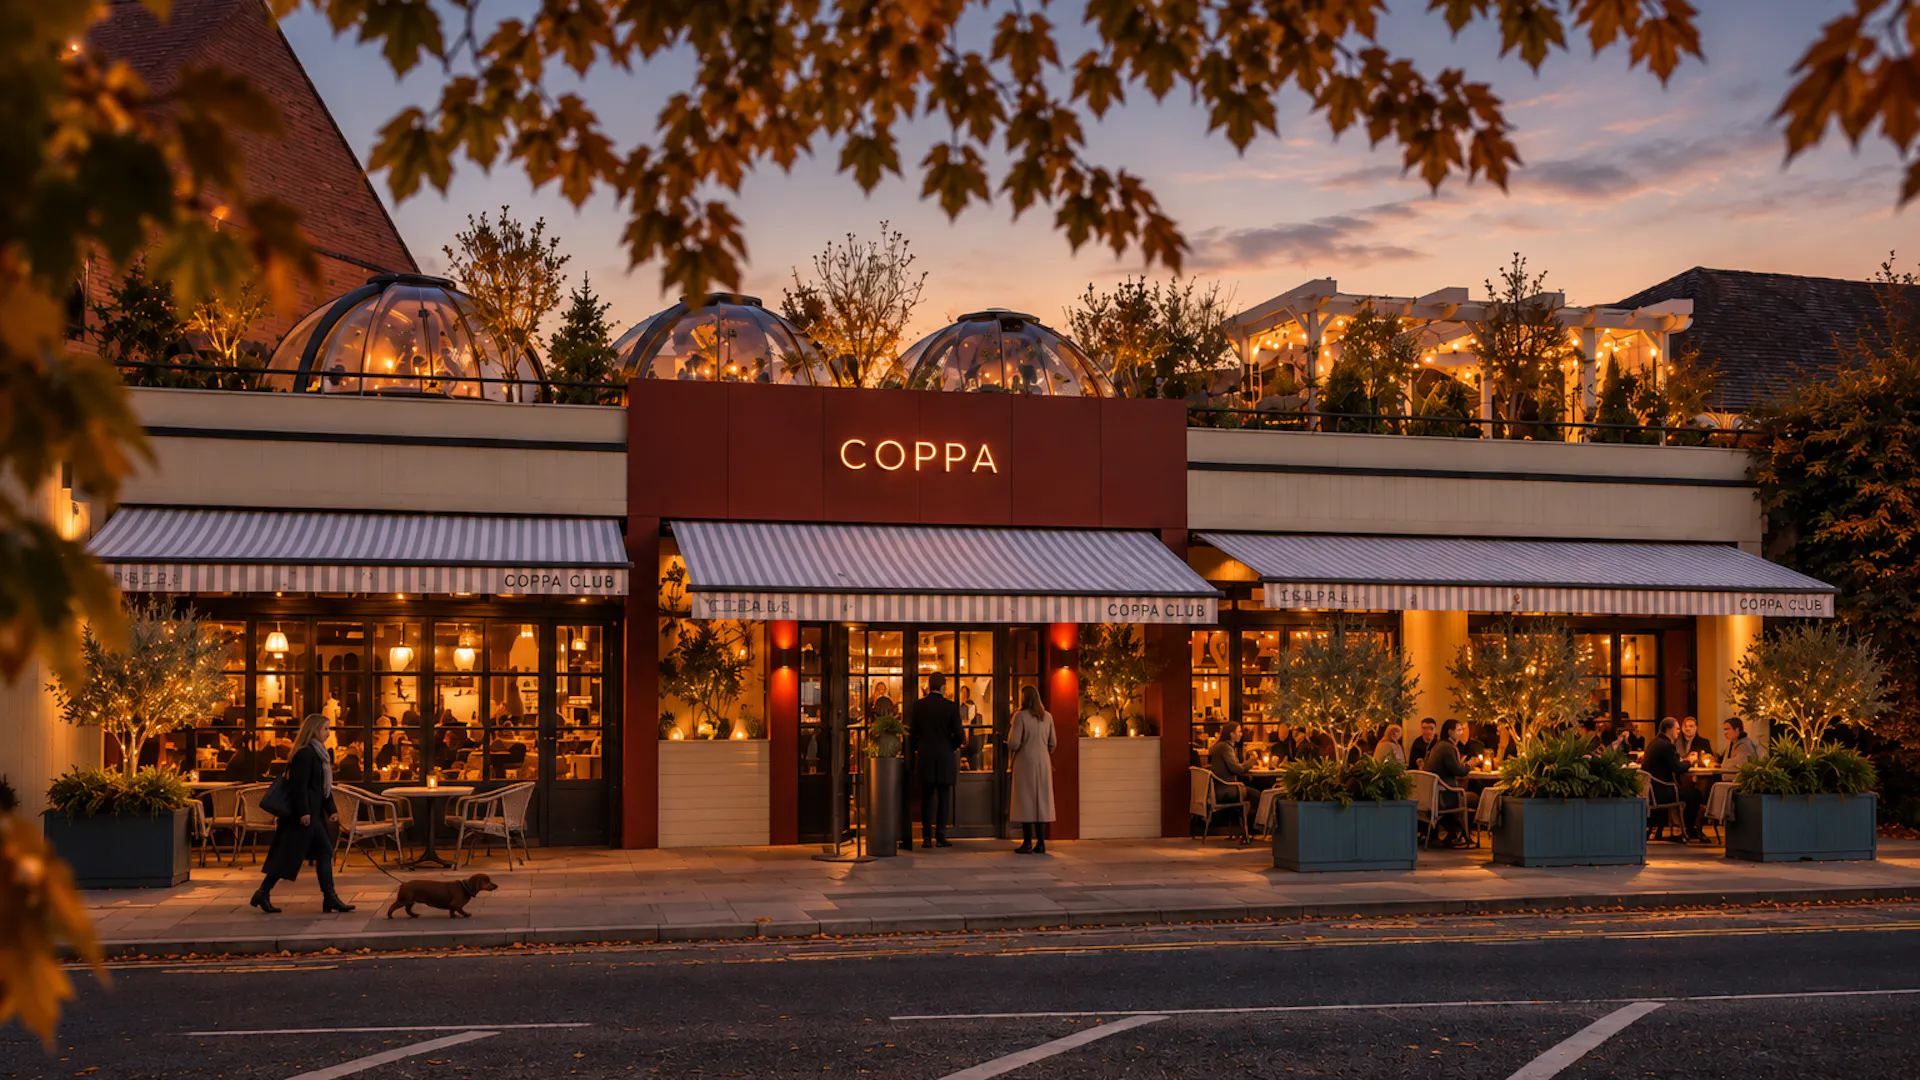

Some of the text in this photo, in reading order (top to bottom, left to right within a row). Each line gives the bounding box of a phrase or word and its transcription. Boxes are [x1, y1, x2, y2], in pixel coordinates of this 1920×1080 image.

[840, 438, 998, 474] COPPA
[504, 574, 614, 589] COPPA CLUB
[1108, 603, 1205, 617] COPPA CLUB
[1740, 598, 1822, 611] COPPA CLUB
